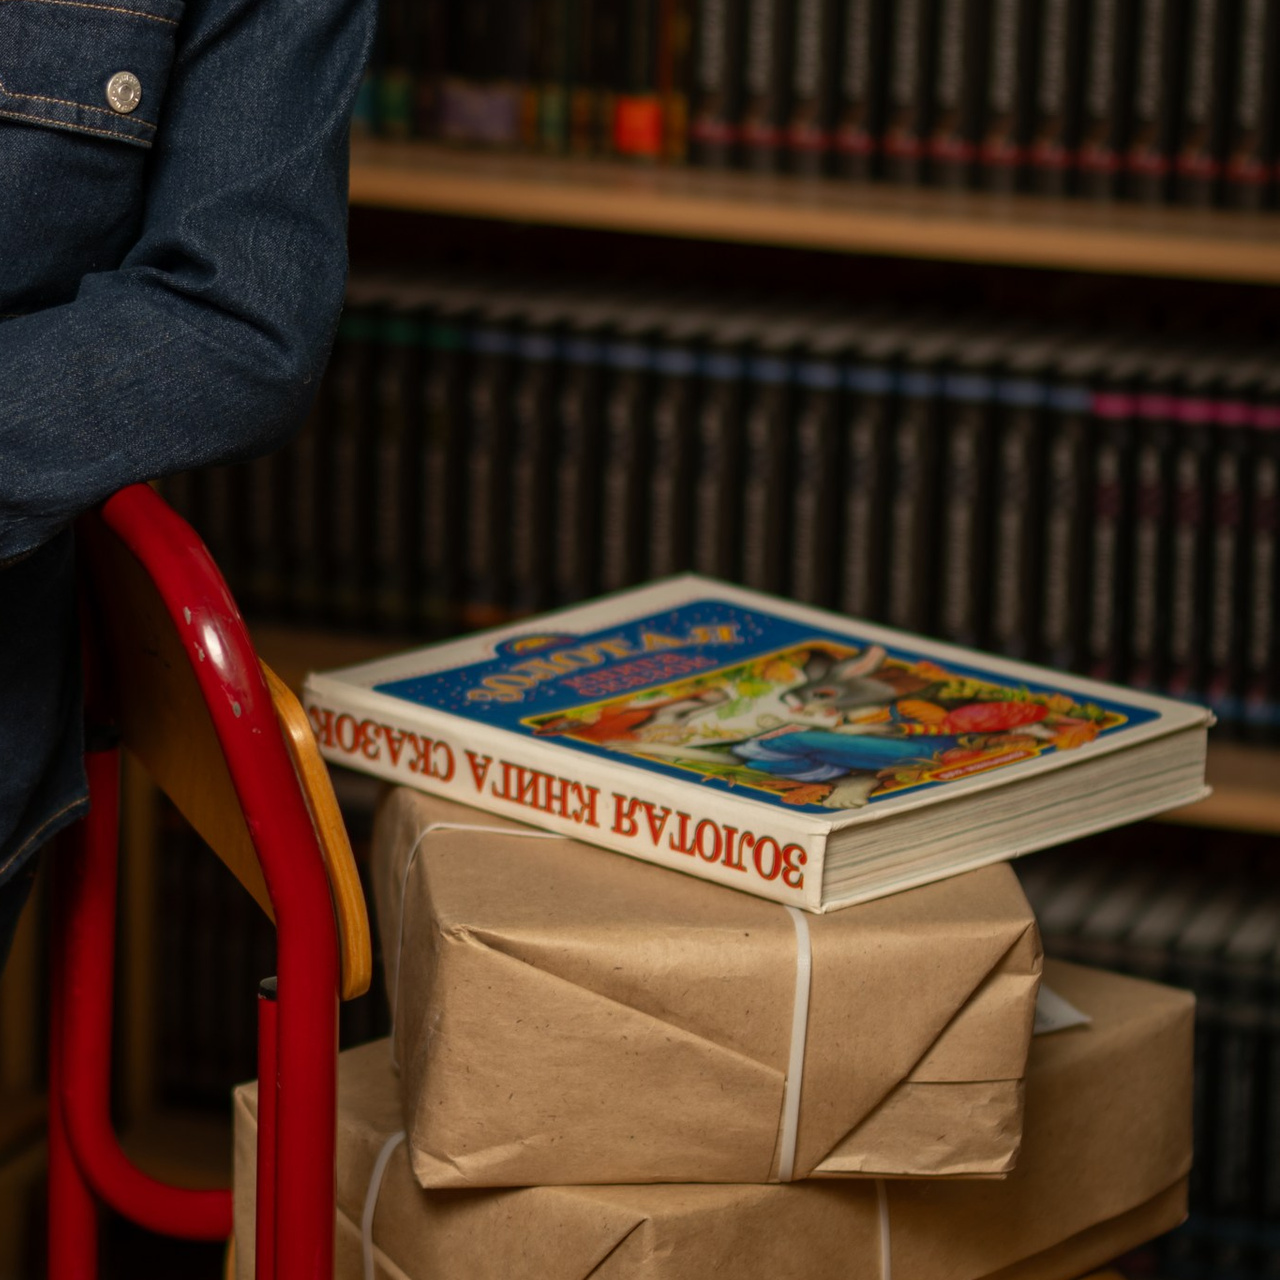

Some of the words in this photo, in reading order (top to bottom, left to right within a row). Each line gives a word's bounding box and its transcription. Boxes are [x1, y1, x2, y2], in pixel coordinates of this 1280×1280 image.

[309, 705, 456, 784] СКАЗОК
[464, 749, 601, 828] КНИГА
[611, 792, 808, 890] ЗОЛОТАЯ
